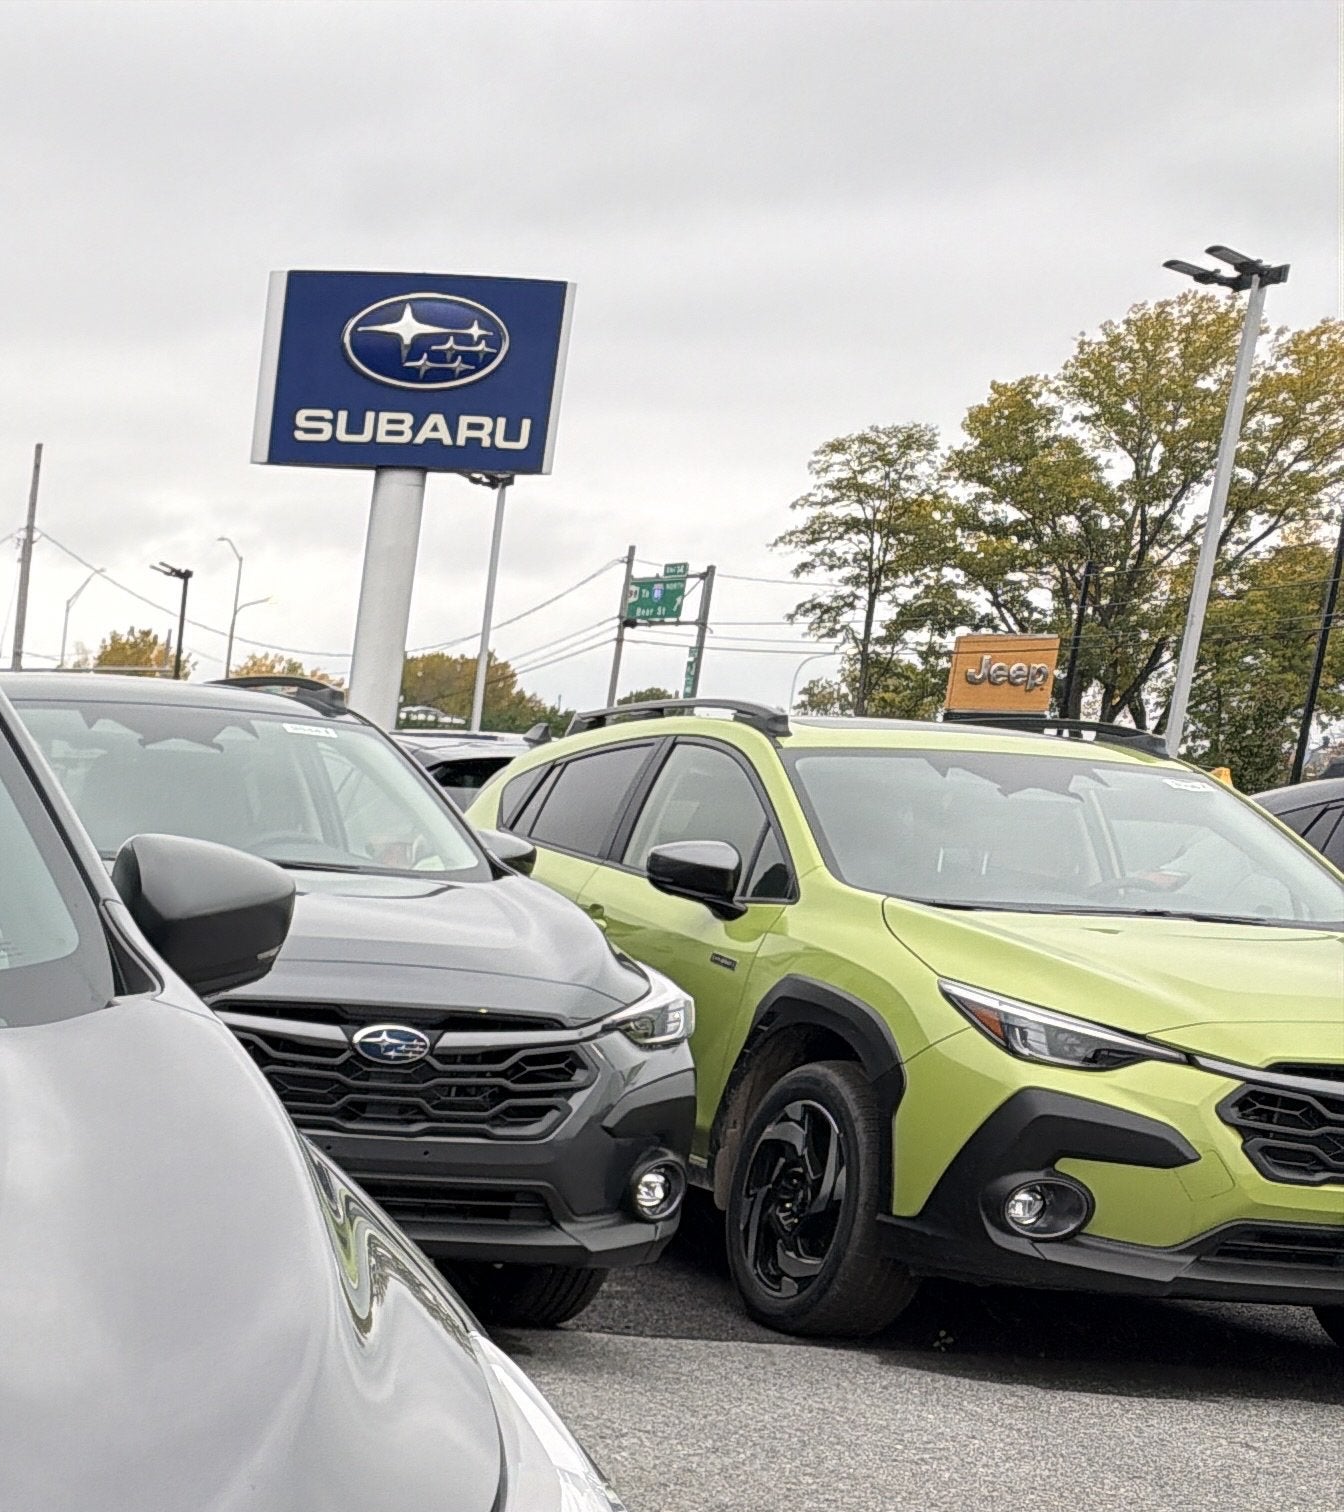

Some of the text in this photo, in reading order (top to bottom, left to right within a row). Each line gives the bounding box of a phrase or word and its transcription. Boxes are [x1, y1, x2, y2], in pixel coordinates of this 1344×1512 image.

[293, 408, 531, 450] SUBARU
[656, 606, 666, 616] St
[966, 655, 1049, 691] Jeep
